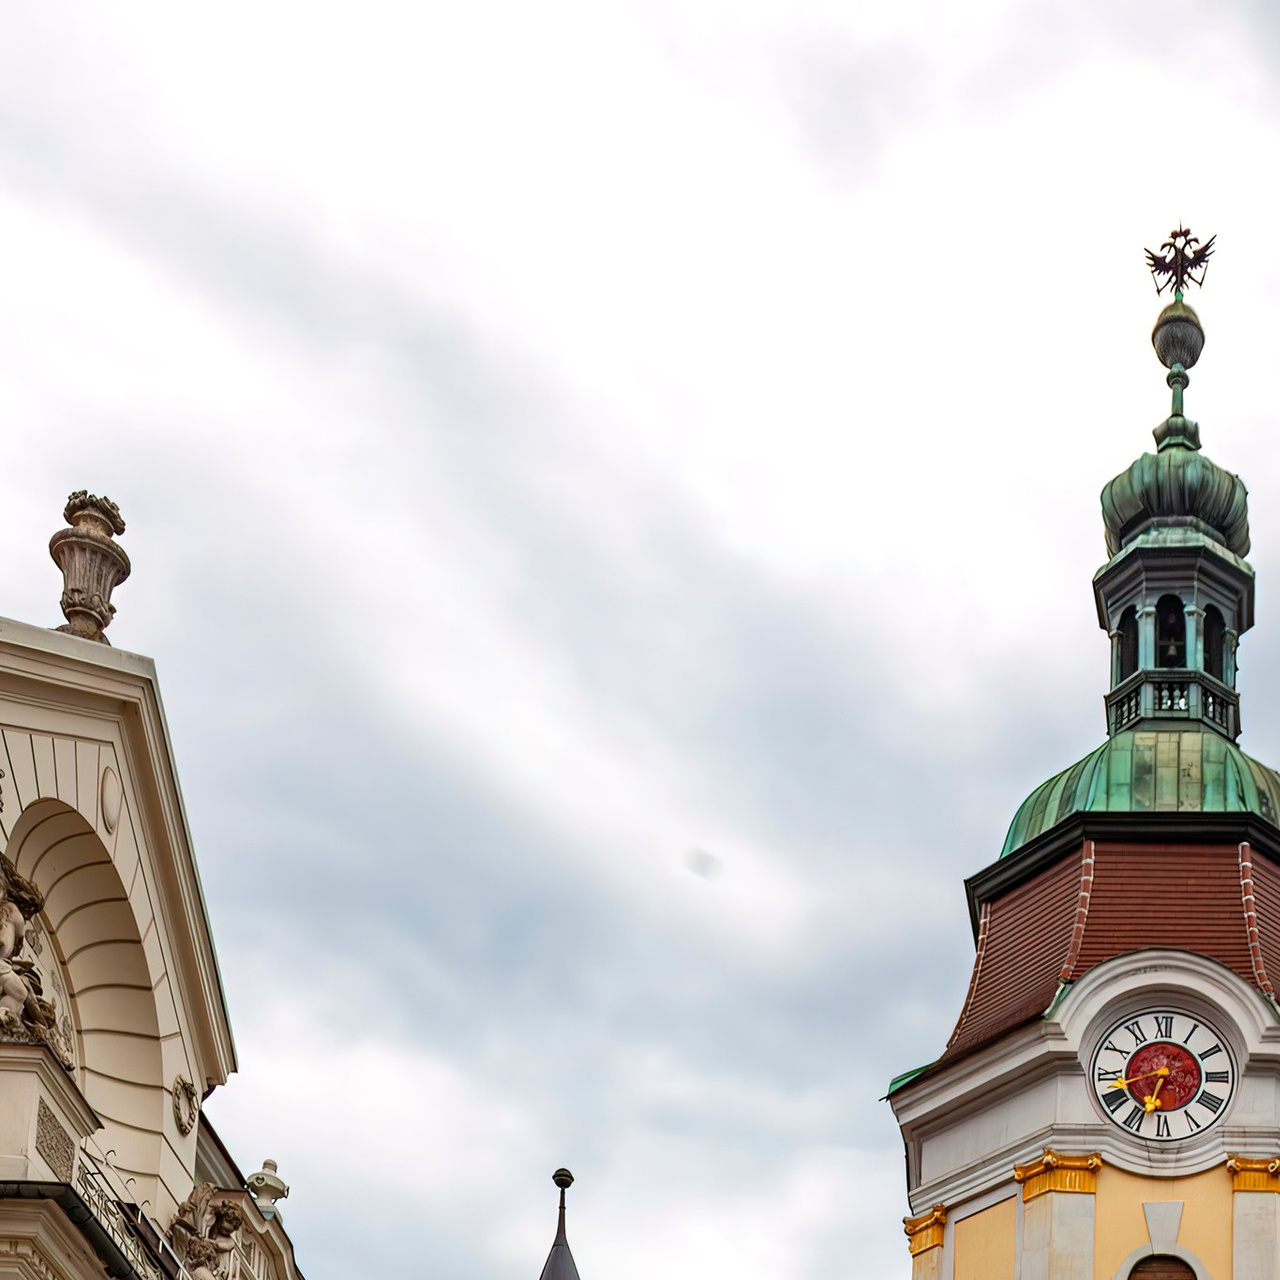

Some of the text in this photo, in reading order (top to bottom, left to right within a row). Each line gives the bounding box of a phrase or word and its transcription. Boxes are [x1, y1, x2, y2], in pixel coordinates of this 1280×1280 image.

[1124, 1020, 1148, 1047] XI
[1154, 1016, 1174, 1039] XII
[1104, 1040, 1130, 1060] X
[1198, 1043, 1222, 1061] II
[1205, 1070, 1229, 1084] III
[1156, 1114, 1171, 1137] VI
[1184, 1110, 1201, 1132] V
